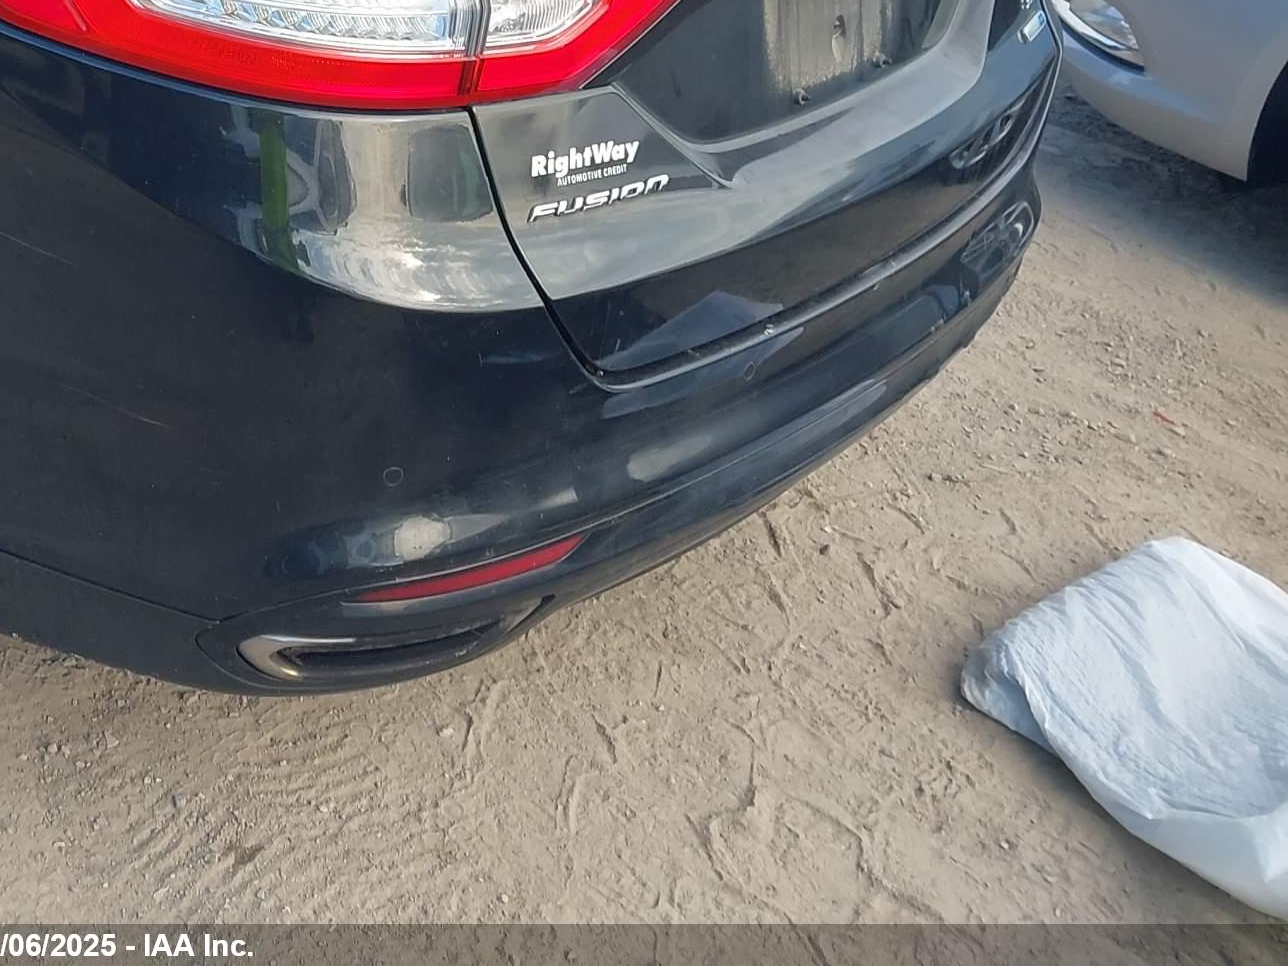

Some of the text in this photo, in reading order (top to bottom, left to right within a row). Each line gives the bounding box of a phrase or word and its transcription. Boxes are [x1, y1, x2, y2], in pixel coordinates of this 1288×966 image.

[531, 140, 640, 178] RightWay
[557, 163, 628, 186] AUTOMOTIVE CREDIT
[528, 174, 670, 222] FUSION
